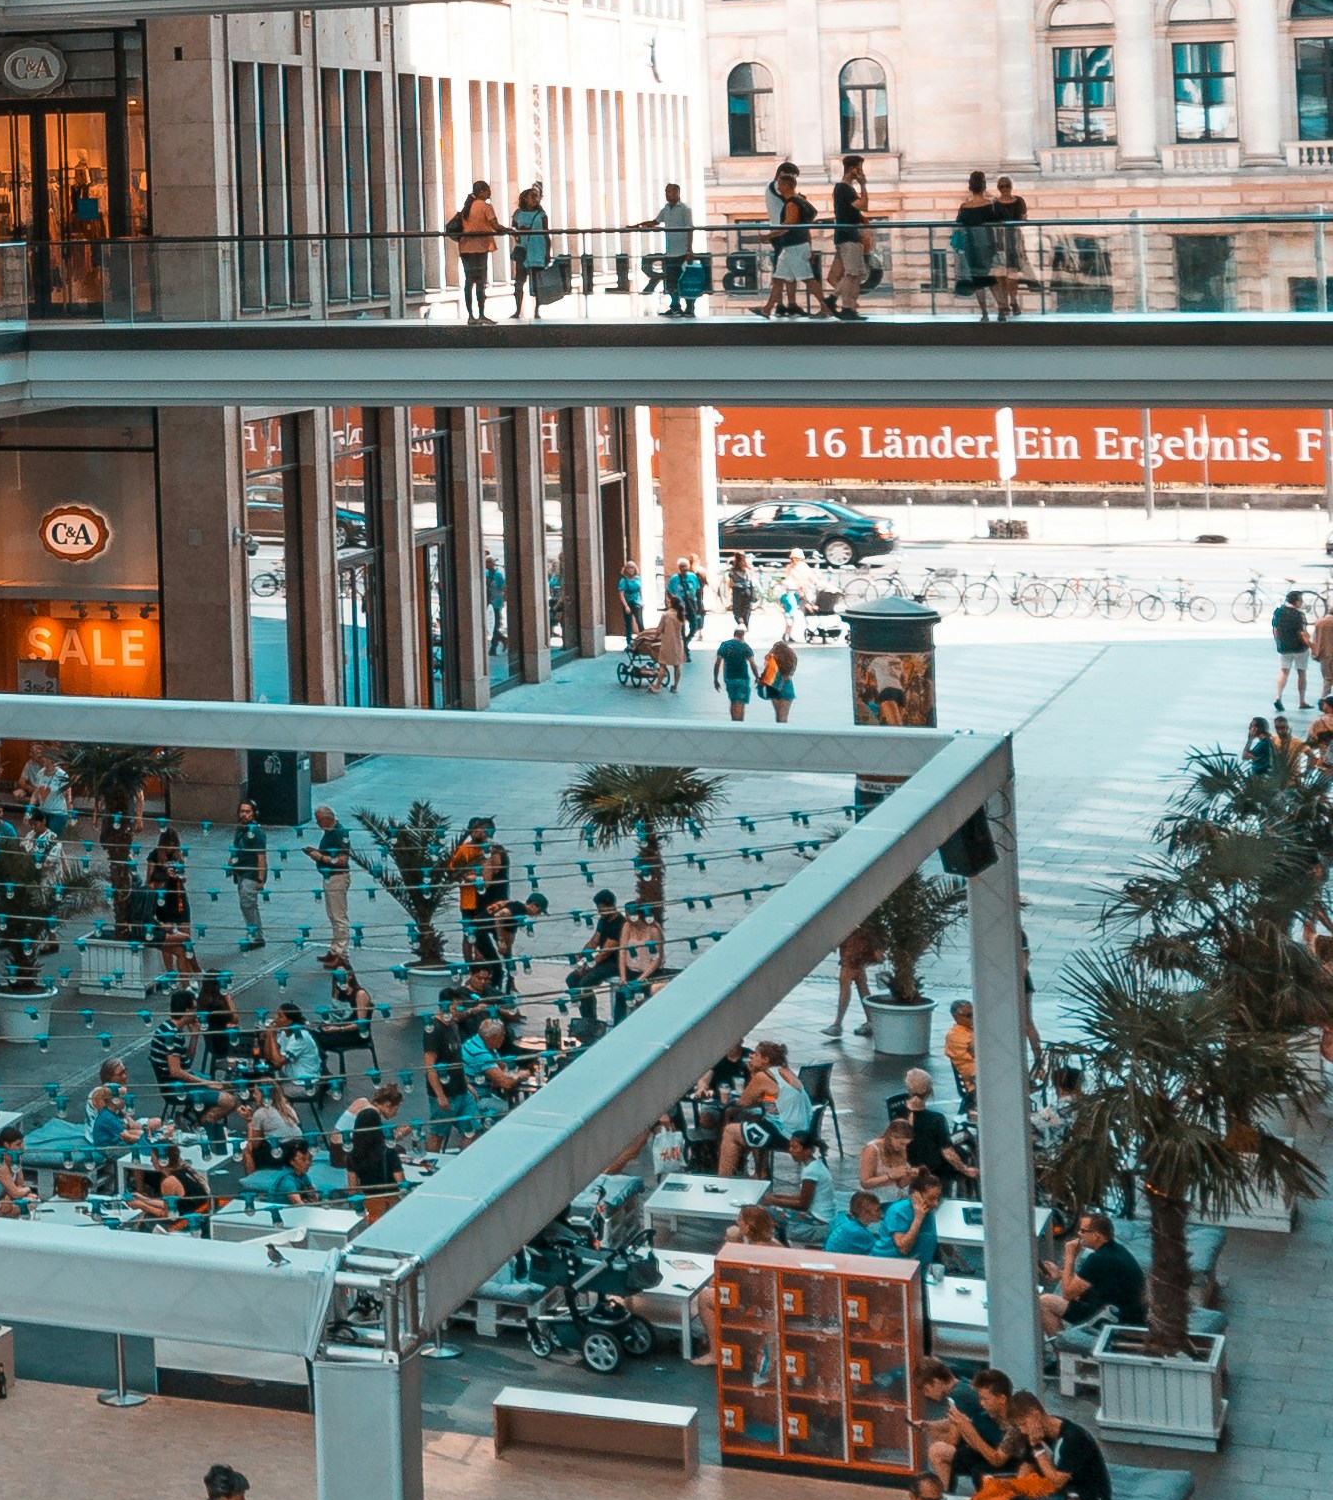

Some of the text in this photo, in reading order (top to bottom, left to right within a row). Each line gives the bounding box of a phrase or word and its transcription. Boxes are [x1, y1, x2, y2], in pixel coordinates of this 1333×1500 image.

[10, 54, 57, 81] C&A
[804, 427, 847, 460] 16
[859, 425, 1000, 460] Länder.
[1016, 427, 1081, 461] Ein
[1094, 426, 1282, 470] Ergebnis.
[51, 522, 94, 546] C&A
[27, 626, 146, 667] SALE
